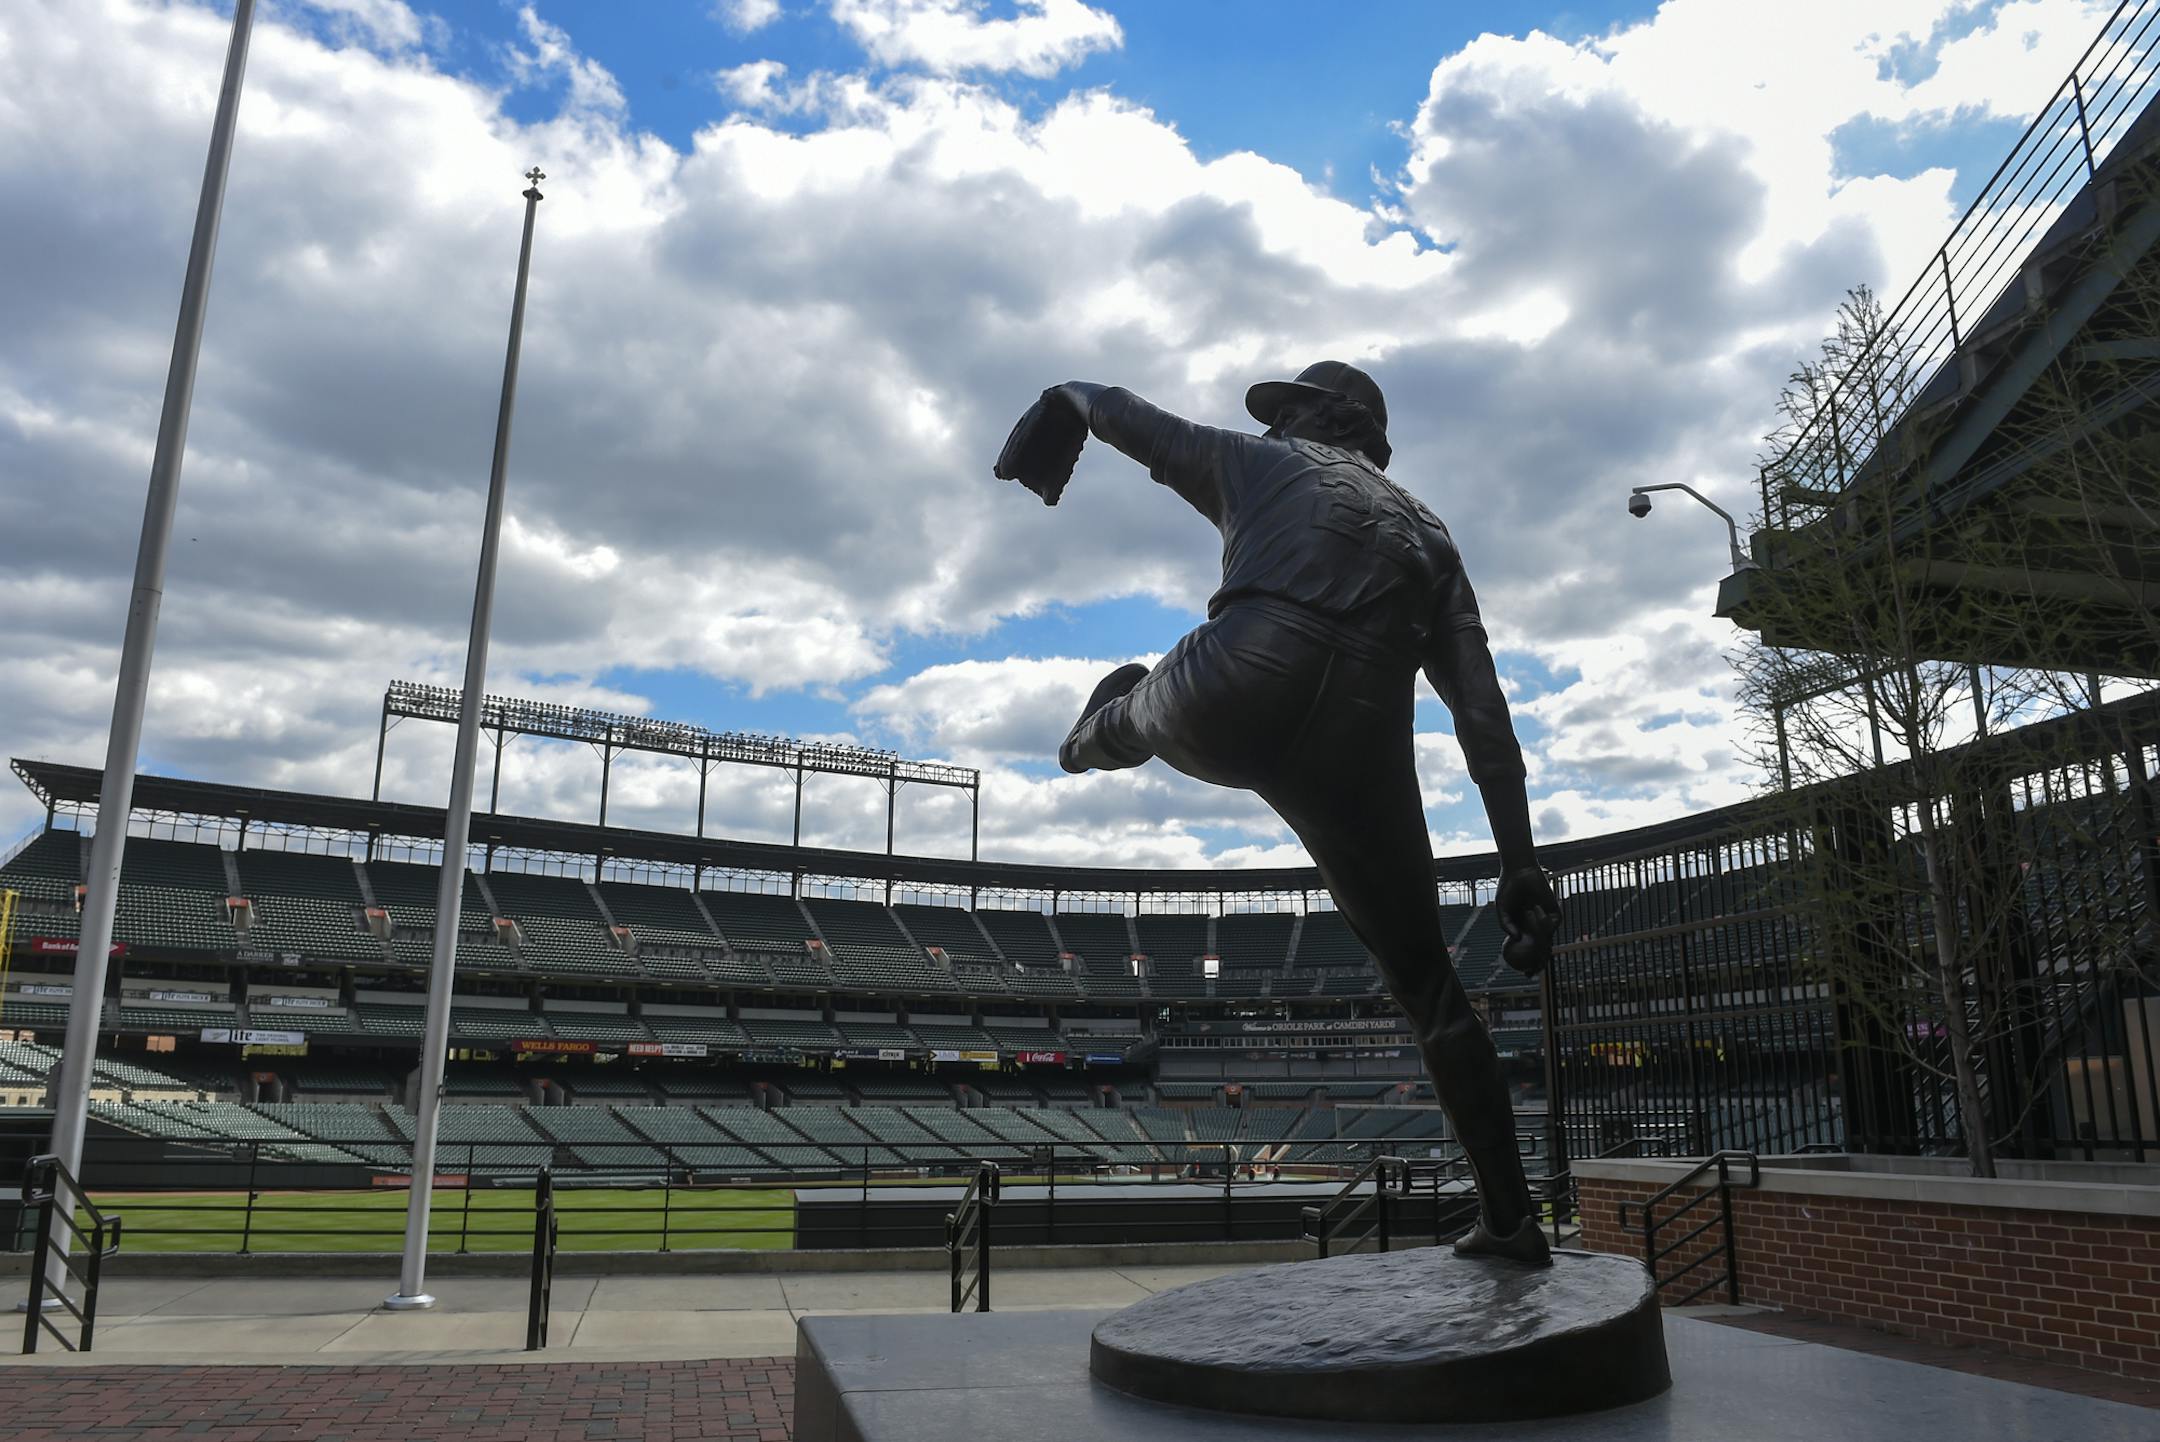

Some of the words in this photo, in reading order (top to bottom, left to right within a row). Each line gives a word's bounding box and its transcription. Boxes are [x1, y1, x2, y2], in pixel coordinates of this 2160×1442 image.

[42, 942, 61, 950] Bank
[1272, 1023, 1304, 1031] ORIOLE
[1304, 1023, 1326, 1031] PARK
[1333, 1022, 1368, 1030] CAMDEN
[1368, 1020, 1396, 1029] YARDS
[521, 1041, 557, 1051] WELLS
[557, 1042, 591, 1052] FARGO
